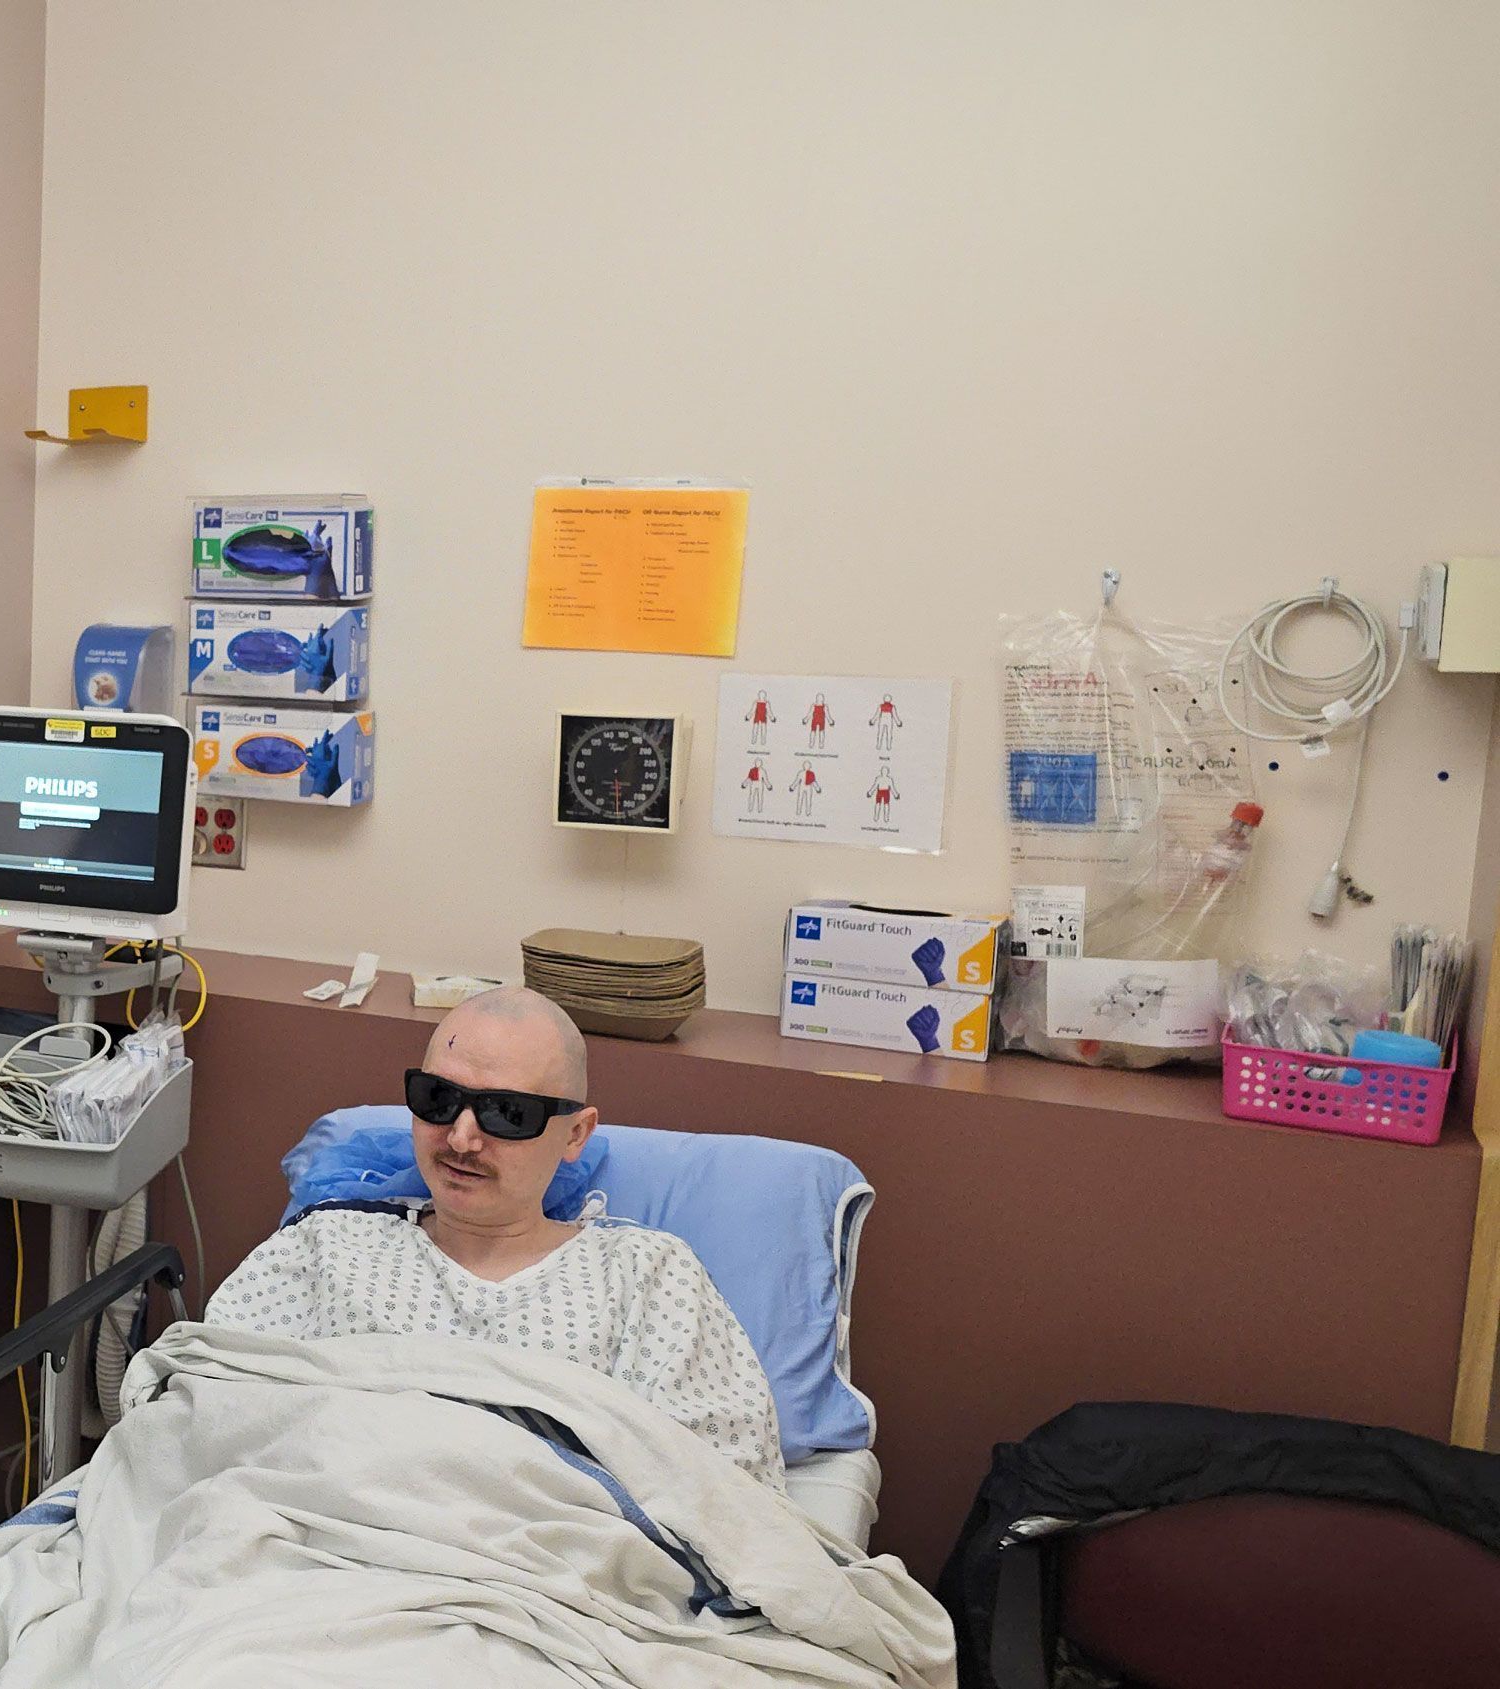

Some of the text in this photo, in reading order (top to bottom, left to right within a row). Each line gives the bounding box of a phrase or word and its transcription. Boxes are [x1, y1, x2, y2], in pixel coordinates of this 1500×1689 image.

[201, 541, 213, 560] L
[195, 641, 211, 659] M
[203, 743, 215, 760] S
[25, 776, 98, 798] PHILIPS
[39, 884, 66, 893] PHILIPS
[826, 918, 912, 937] FitGuard Touch
[965, 960, 981, 982] S
[821, 983, 907, 1004] FitGuard Touch
[960, 1029, 976, 1050] S
